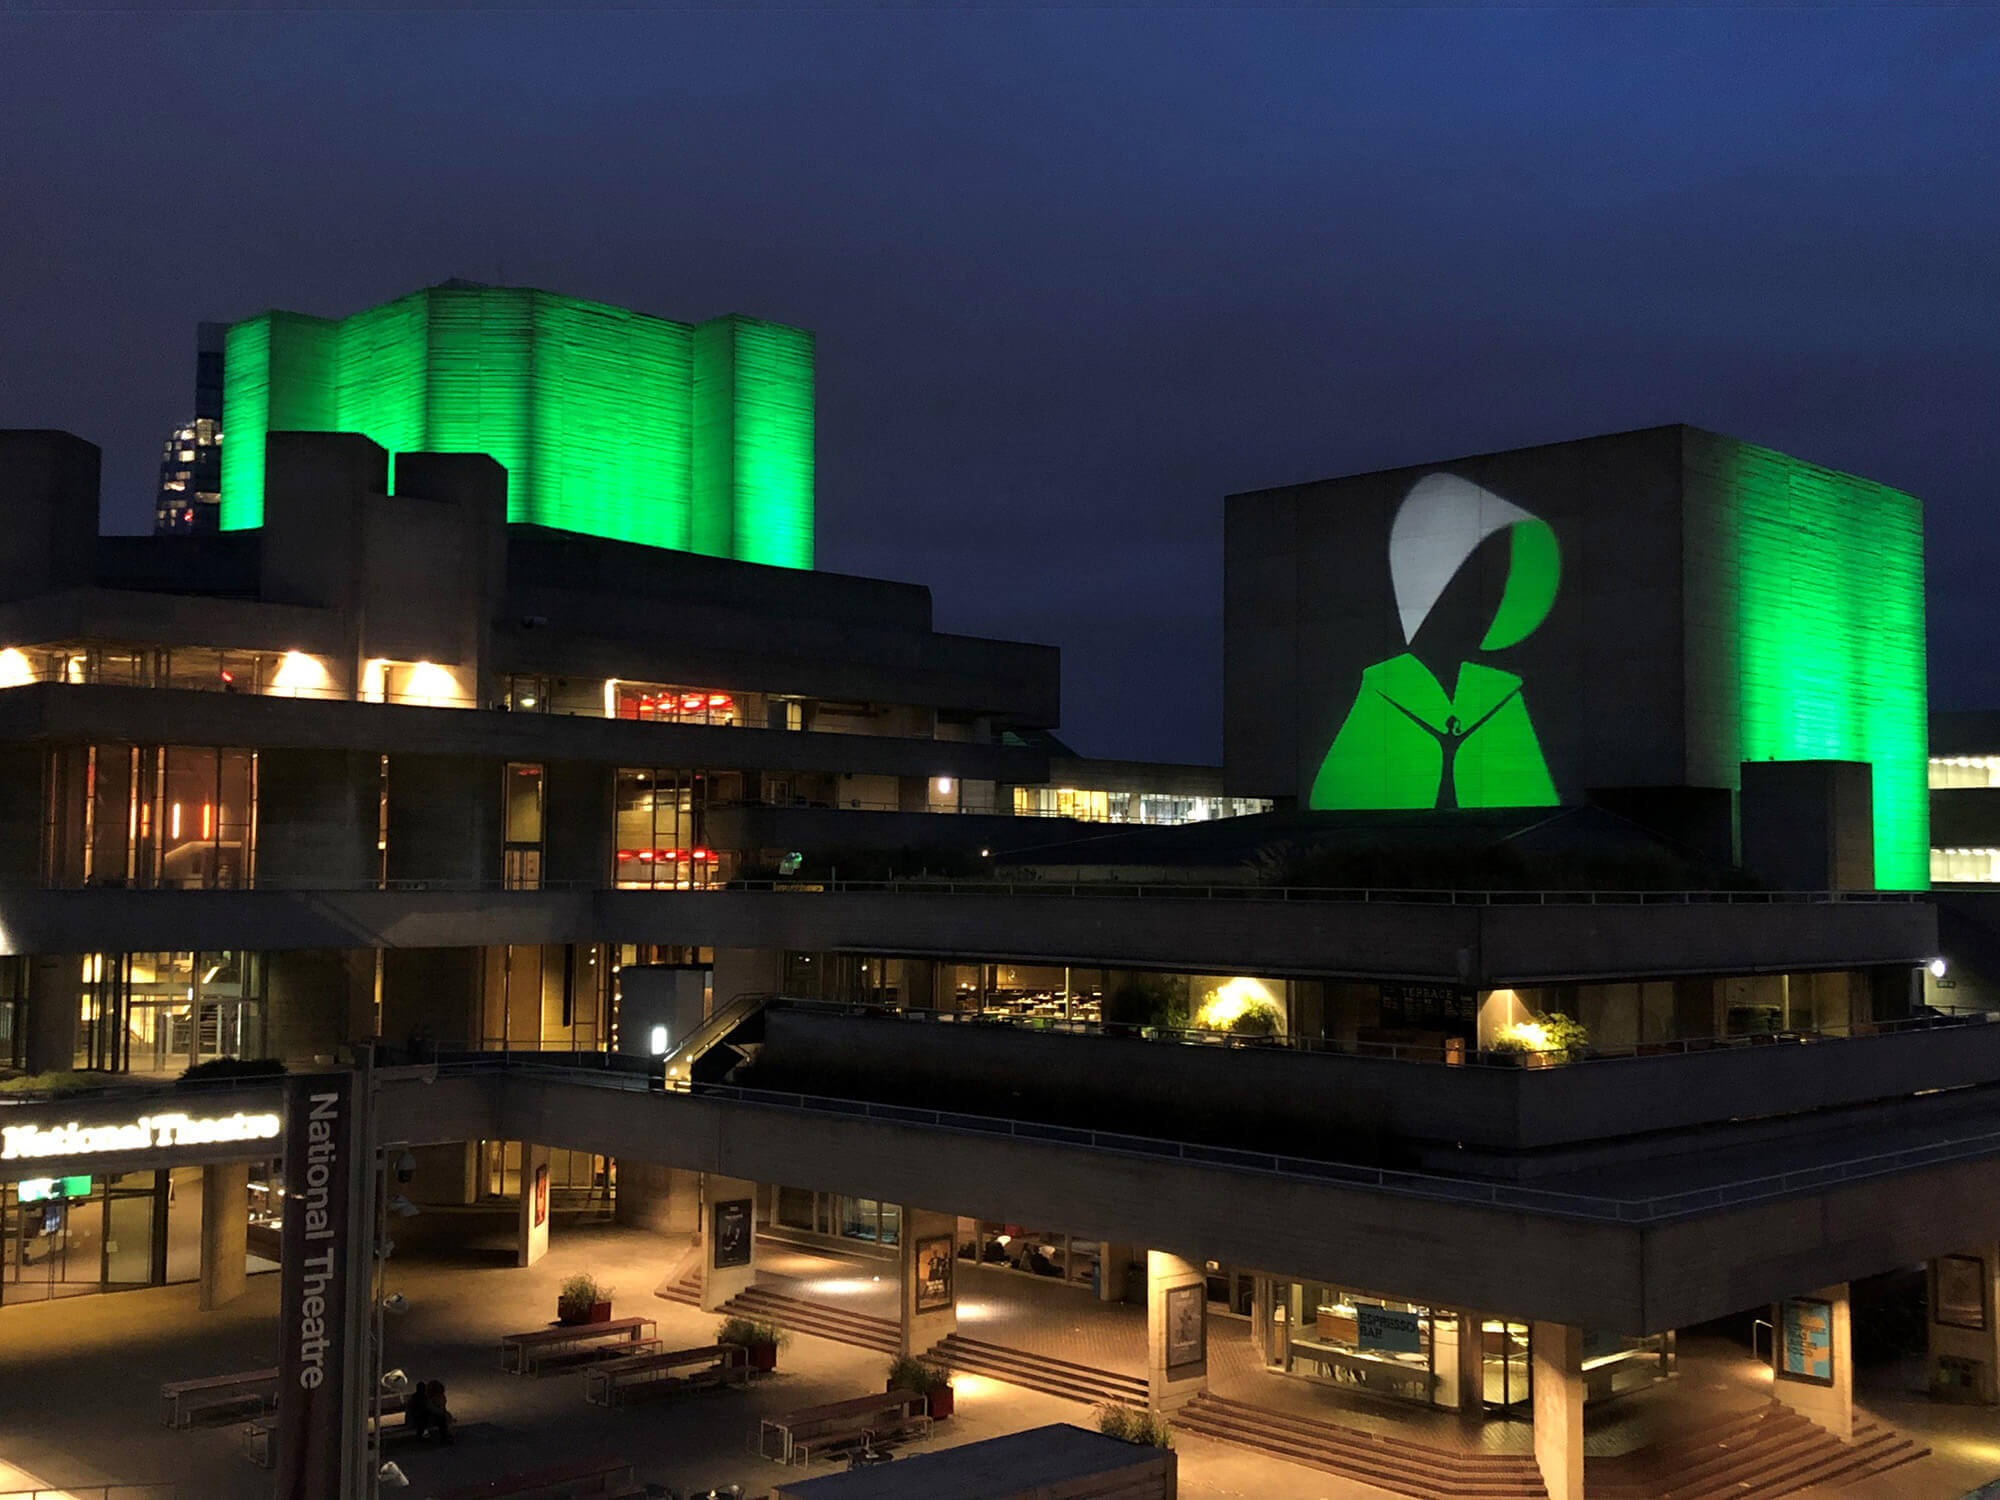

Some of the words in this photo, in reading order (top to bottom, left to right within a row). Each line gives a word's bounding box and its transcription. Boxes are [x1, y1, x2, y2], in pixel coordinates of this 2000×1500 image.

[1402, 986, 1454, 999] TERRACE
[1, 1115, 152, 1160] National
[151, 1112, 281, 1147] Theatre
[305, 1091, 339, 1240] National
[299, 1247, 335, 1390] Theatre
[1359, 1312, 1416, 1333] ESPRESSO
[1359, 1325, 1383, 1338] BAR
